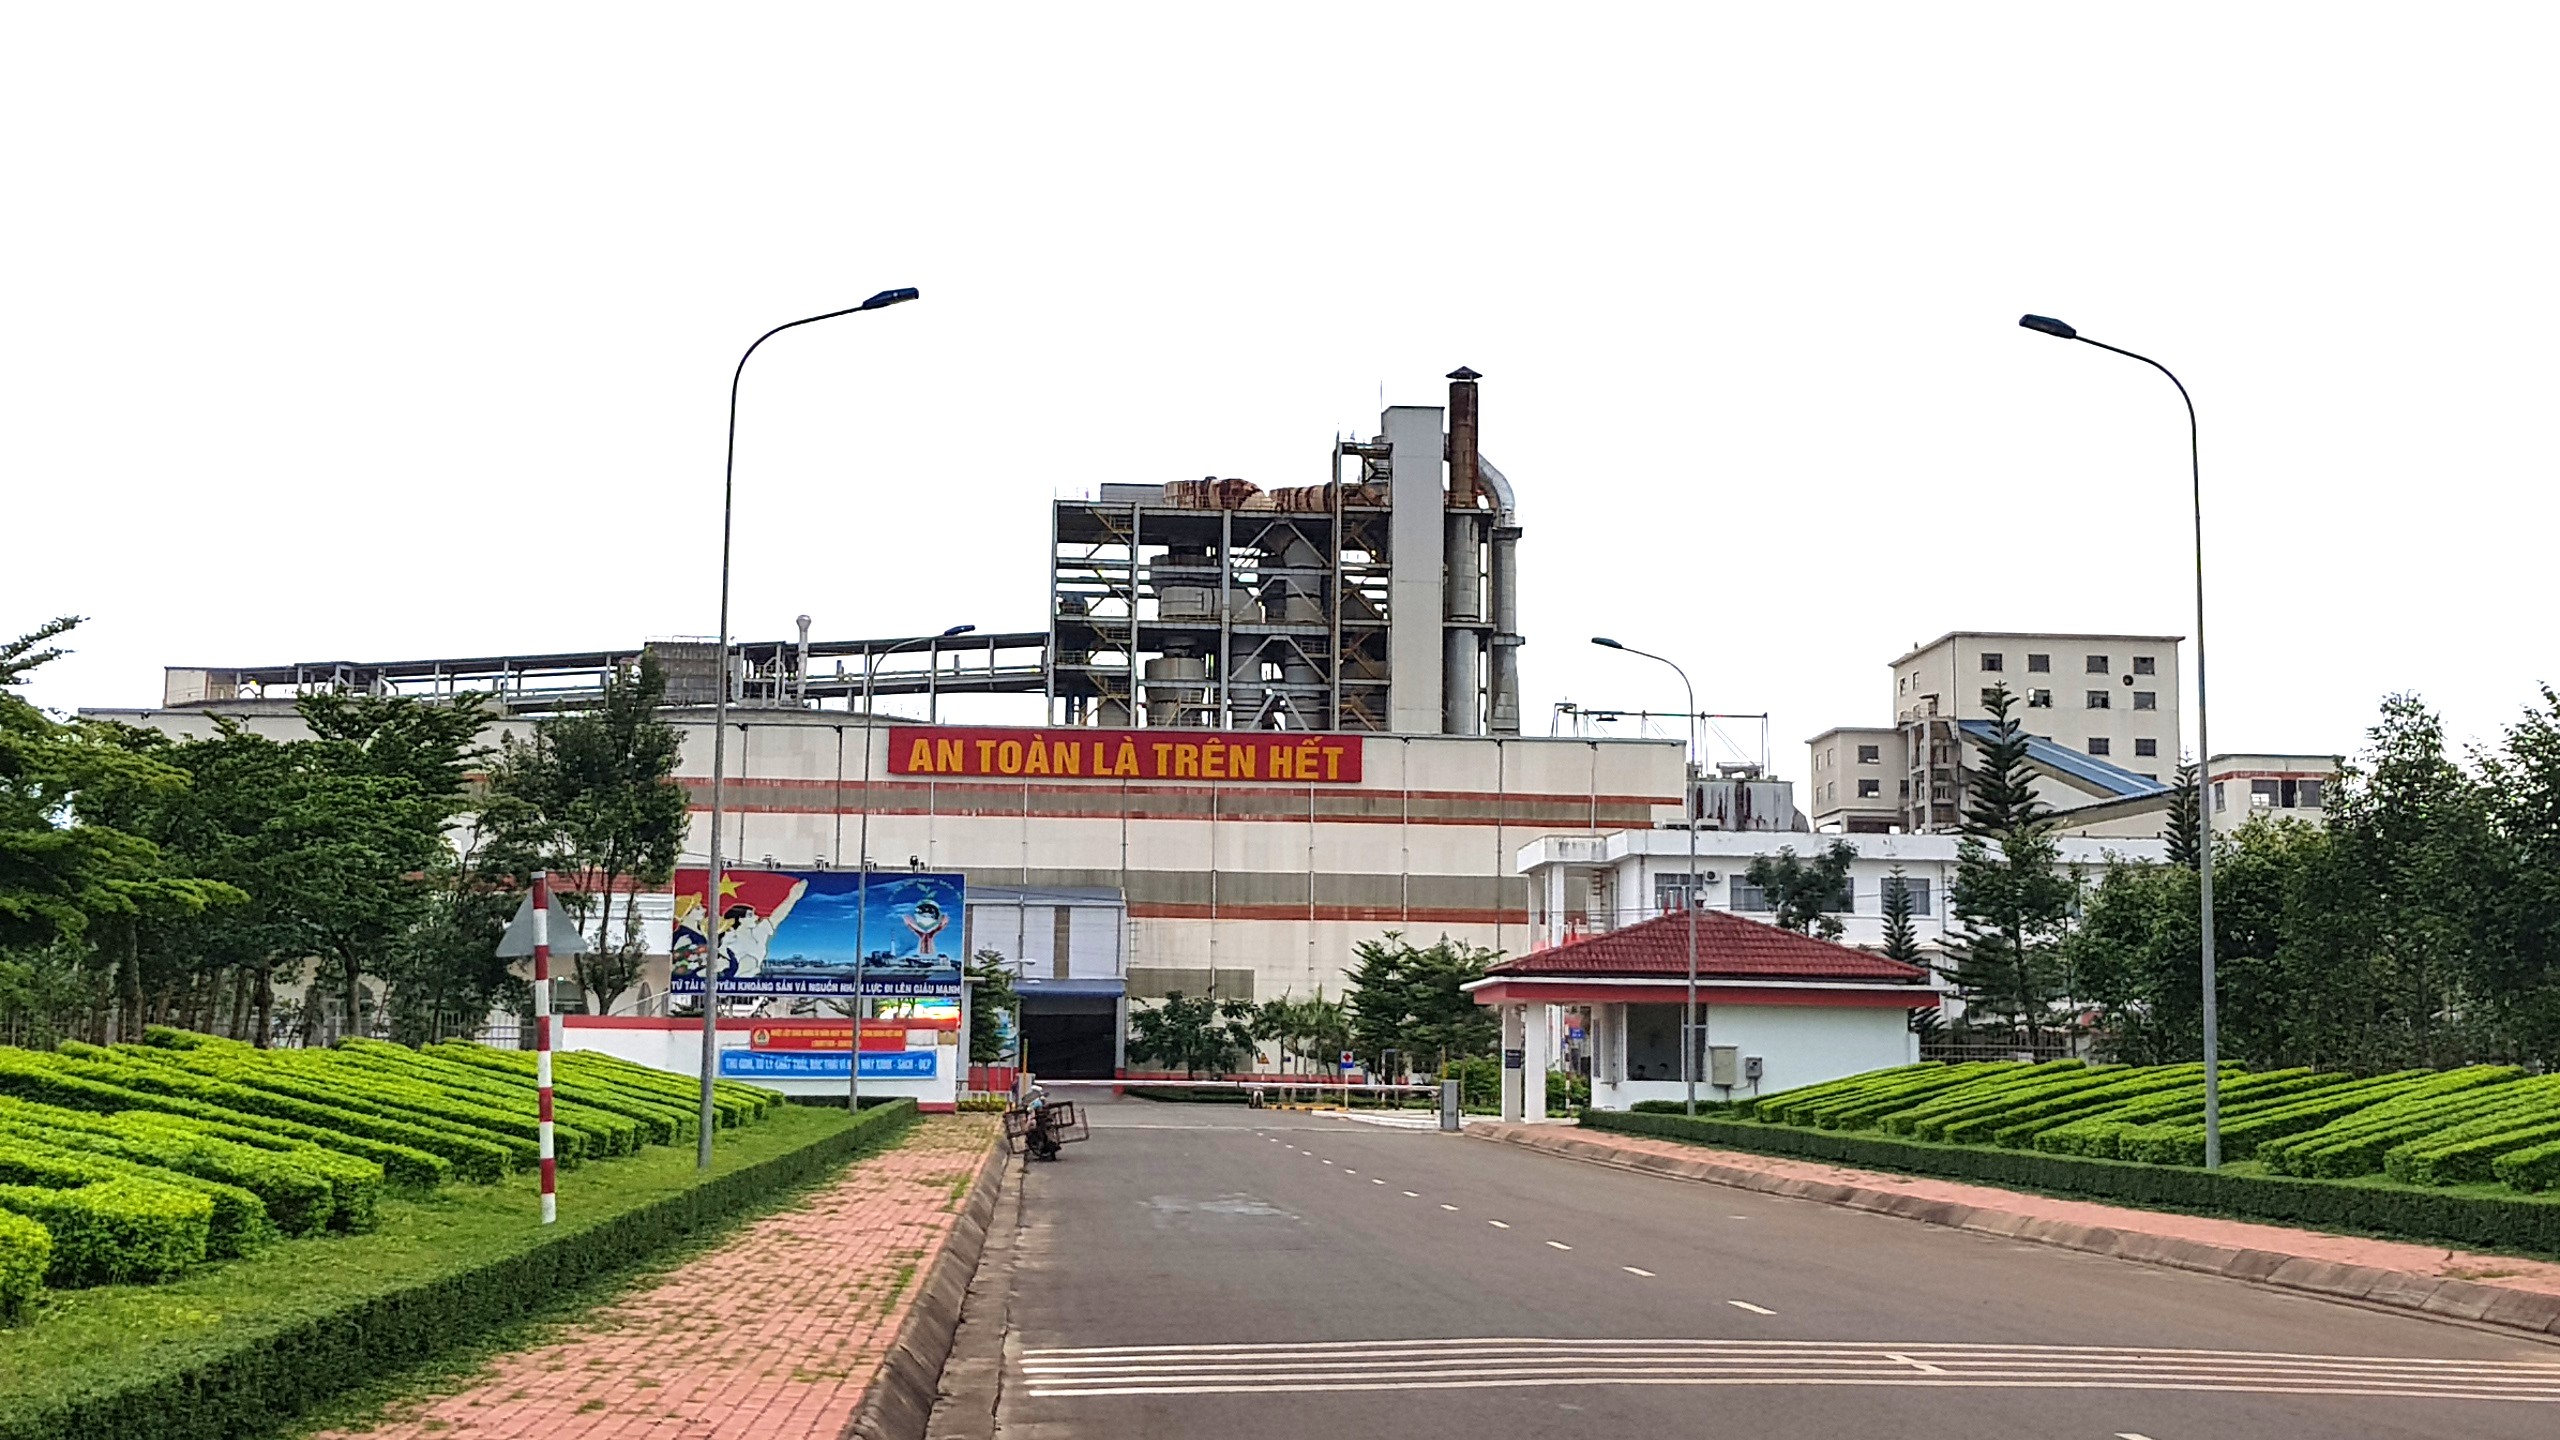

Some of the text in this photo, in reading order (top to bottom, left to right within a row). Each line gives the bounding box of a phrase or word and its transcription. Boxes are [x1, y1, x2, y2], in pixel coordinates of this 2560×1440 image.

[908, 734, 1344, 780] AN TOÀN LÀ TRÊN HẾT
